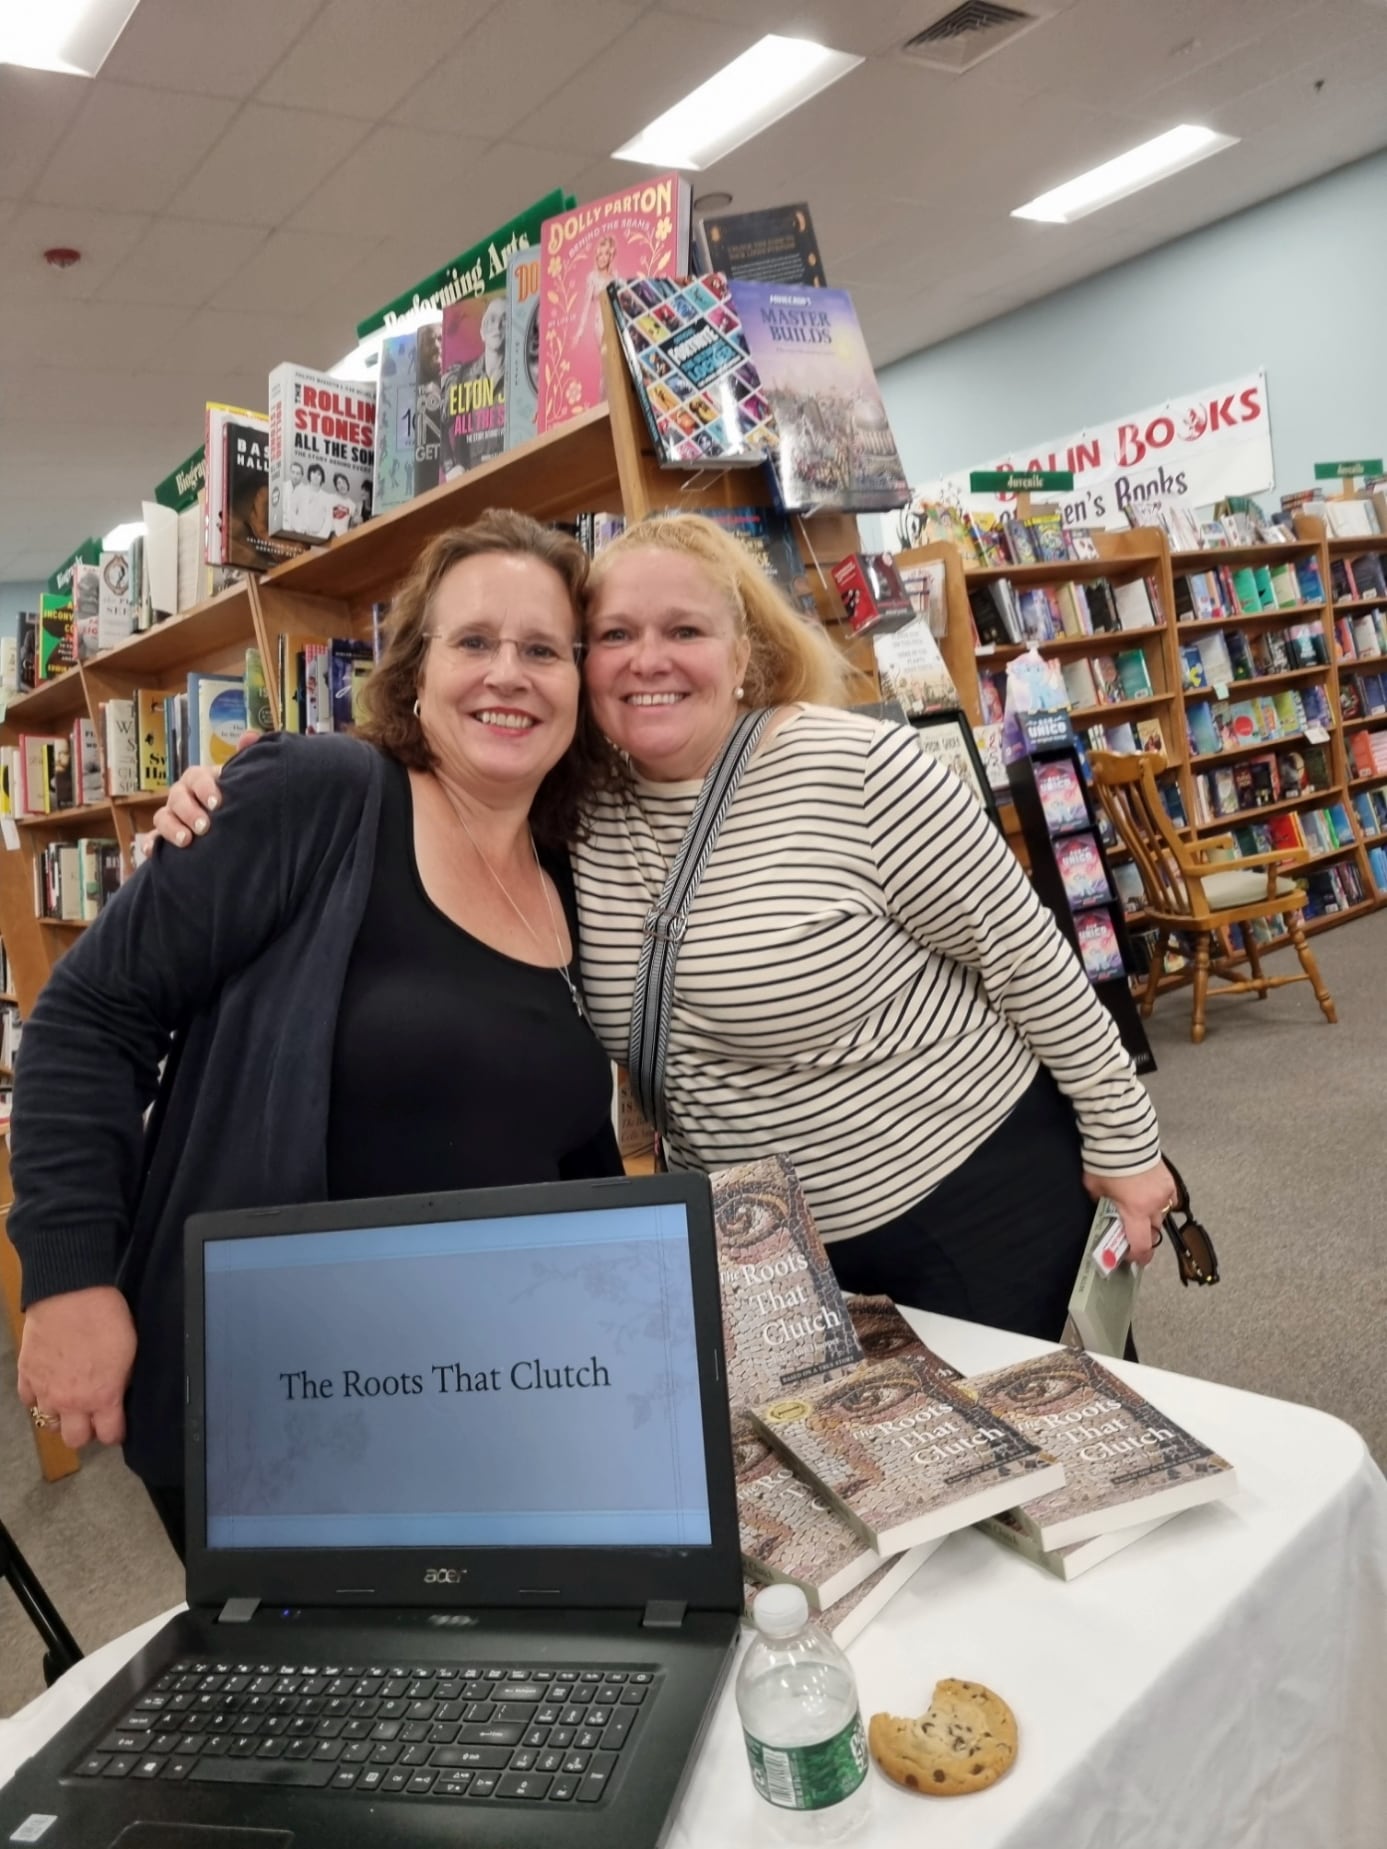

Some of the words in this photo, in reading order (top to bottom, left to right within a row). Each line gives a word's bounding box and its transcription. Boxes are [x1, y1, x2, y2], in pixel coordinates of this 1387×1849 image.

[548, 206, 602, 255] DOLLY
[603, 179, 672, 217] PARTON
[601, 220, 619, 233] THE
[761, 307, 831, 327] MASTER
[769, 325, 832, 344] BUILDS
[449, 376, 494, 416] ELTON
[294, 408, 374, 448] STONES
[454, 411, 473, 436] ALL
[1115, 387, 1262, 467] BOOKS
[294, 431, 319, 453] ALL
[324, 439, 348, 460] THE
[1028, 721, 1067, 738] UNICO
[741, 1253, 808, 1287] Roots
[748, 1283, 809, 1316] That
[762, 1305, 841, 1347] Clutch
[280, 1371, 334, 1400] The
[343, 1368, 423, 1398] Roots
[432, 1362, 501, 1394] That
[510, 1356, 611, 1391] Clutch
[852, 1427, 875, 1441] The
[875, 1402, 953, 1436] Roots
[1040, 1399, 1122, 1429] Roots
[890, 1420, 961, 1449] That
[915, 1427, 1005, 1464] Clutch
[1056, 1417, 1129, 1445] That
[1079, 1427, 1175, 1462] Clutch
[423, 1566, 467, 1584] acer
